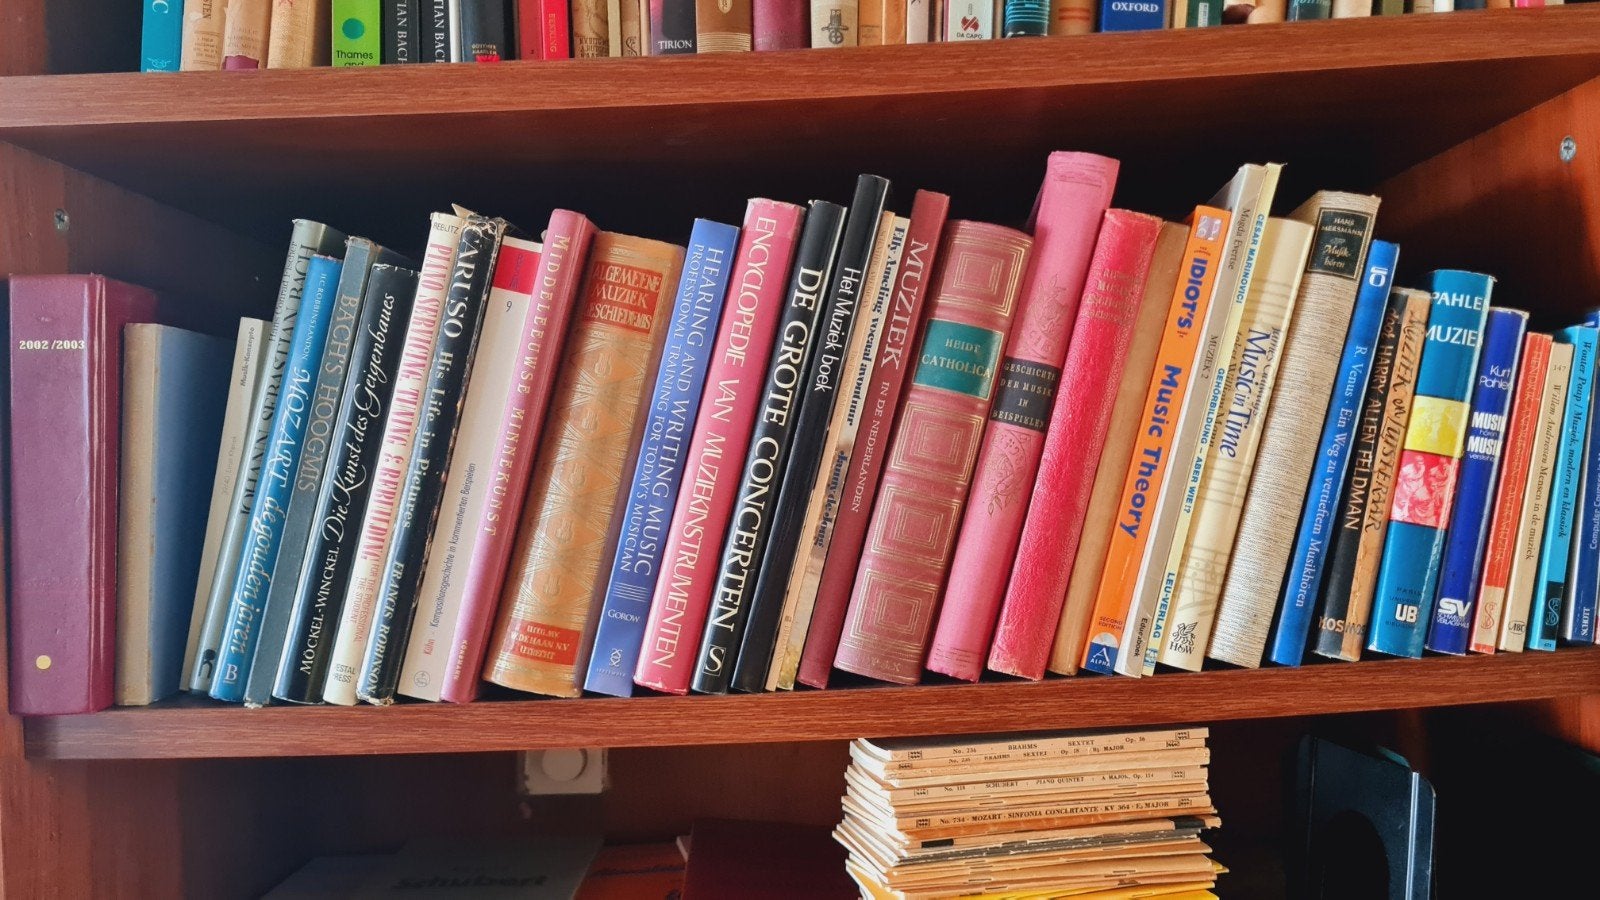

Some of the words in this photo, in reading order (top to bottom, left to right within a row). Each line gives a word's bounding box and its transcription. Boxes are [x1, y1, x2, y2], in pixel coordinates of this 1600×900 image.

[1111, 2, 1159, 13] OXFORD
[336, 50, 374, 60] Thames
[658, 40, 692, 50] TIRION
[1234, 207, 1250, 237] Magda
[1249, 213, 1264, 247] CESAR
[420, 242, 453, 291] PIANO
[1226, 238, 1242, 271] Evertse
[440, 225, 486, 340] CARUSO
[592, 280, 650, 307] MUZIEK
[674, 243, 705, 341] PROFESSIONAL
[723, 215, 777, 367] ENCYCLOPEDIE
[790, 265, 822, 310] DE
[838, 266, 861, 296] Het
[1177, 257, 1207, 330] IDIOT'S
[1235, 247, 1256, 303] MARINOVICI
[516, 233, 570, 394] MIDDELEEUWSE
[687, 247, 724, 347] HEARING
[879, 237, 929, 371] MUZIEK
[301, 324, 314, 360] LANDON
[325, 294, 358, 375] BACH'S
[399, 294, 442, 383] SERVICING
[825, 297, 851, 350] Muziek
[354, 293, 395, 417] Geigenbaues
[434, 351, 454, 381] His
[678, 352, 696, 392] AND
[761, 318, 810, 426] GROTE
[920, 353, 992, 378] CATHOLICA
[1203, 335, 1218, 370] MUZIEK
[1234, 327, 1270, 395] Music
[1353, 345, 1365, 359] R.
[1369, 343, 1393, 393] HARRY
[1490, 365, 1511, 377] Kurt
[1578, 341, 1591, 375] Wouter
[655, 343, 682, 413] TRAINING
[814, 355, 839, 392] boek
[879, 380, 890, 396] IN
[1000, 377, 1019, 389] DER
[1021, 382, 1052, 397] MUSIK
[1343, 362, 1361, 397] Venus
[1572, 376, 1586, 402] Paap
[385, 385, 420, 447] TUNING
[423, 386, 447, 423] Life
[709, 375, 740, 421] VAN
[873, 398, 885, 416] DE
[1017, 397, 1029, 407] IN
[1148, 364, 1182, 437] Music
[1199, 367, 1226, 444] GEHÖRBILDUNG
[1231, 392, 1248, 408] in
[1336, 407, 1351, 428] Ein
[1547, 384, 1563, 415] Willem
[266, 366, 309, 488] MOZART
[297, 384, 340, 492] HOOGMIS
[352, 414, 369, 443] des
[418, 429, 436, 450] in
[650, 415, 665, 435] FOR
[1220, 405, 1251, 458] Time
[1326, 431, 1345, 457] Weg
[1541, 417, 1556, 464] Andriessen
[1567, 410, 1583, 446] Muziek,
[635, 435, 660, 500] TODAY'S
[653, 400, 690, 498] WRITING
[850, 419, 879, 513] NEDERLANDEN
[1190, 456, 1203, 482] ABER
[1325, 459, 1336, 473] zu
[1563, 449, 1576, 485] modern
[329, 442, 361, 507] Kunst
[482, 406, 525, 535] MINNEKUNST
[1342, 448, 1373, 530] FELDMAN
[1533, 466, 1548, 501] Mensen
[262, 495, 286, 515] de
[399, 456, 430, 530] Pictures
[1119, 445, 1163, 540] Theory
[1312, 477, 1334, 534] vertieftem
[1532, 502, 1542, 513] in
[1561, 486, 1569, 497] en
[318, 502, 347, 542] Die
[618, 503, 645, 571] MUSICIAN
[710, 434, 781, 631] CONCERTEN
[1529, 513, 1540, 526] de
[1555, 500, 1571, 538] klassiek
[241, 510, 276, 601] gouden
[429, 553, 455, 627] Kompositionsgeschichte
[449, 496, 468, 544] kommentierten
[460, 462, 476, 496] Beispielen
[634, 504, 664, 576] MUSIC
[651, 431, 726, 668] MUZIEKINSTRUMENTEN
[1525, 527, 1537, 561] muziek
[365, 578, 375, 593] THE
[379, 559, 406, 620] FRANCIS
[1295, 537, 1321, 608] Musikhören
[229, 593, 257, 654] jaren
[298, 545, 339, 674] MÖCKEL-WINCKEL
[352, 593, 372, 644] PROFESSIONAL
[608, 609, 640, 623] GOROW
[1150, 570, 1176, 639] LEU-VERLAG
[1395, 604, 1418, 623] UB
[1438, 597, 1471, 617] SV
[363, 623, 391, 694] ROBINSON
[1090, 657, 1110, 667] ALPHA
[1057, 776, 1085, 784] QUINTET
[953, 816, 965, 824] 734
[1008, 811, 1042, 819] SINFONIA
[1045, 806, 1099, 816] CONCERTANTE
